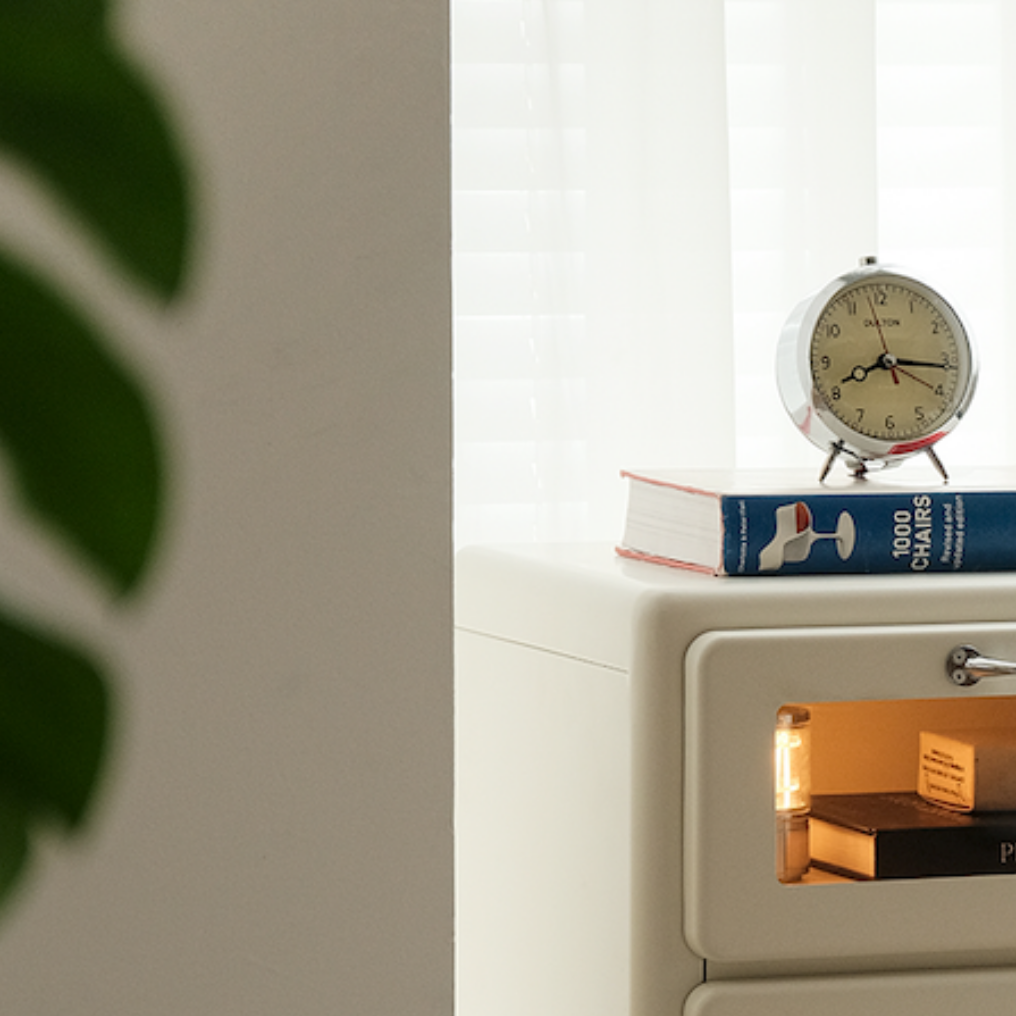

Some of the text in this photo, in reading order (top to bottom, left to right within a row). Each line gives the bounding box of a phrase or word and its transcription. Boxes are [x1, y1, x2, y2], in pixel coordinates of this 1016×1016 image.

[874, 290, 888, 306] 12
[847, 301, 857, 316] 11
[826, 324, 840, 338] 10
[932, 321, 939, 334] 2
[821, 355, 831, 370] 9
[831, 386, 841, 401] 8
[935, 384, 944, 396] 4
[856, 408, 865, 422] 7
[915, 407, 925, 421] 5
[885, 415, 895, 430] 6
[892, 510, 911, 559] 1000
[910, 495, 931, 571] CHAIRS
